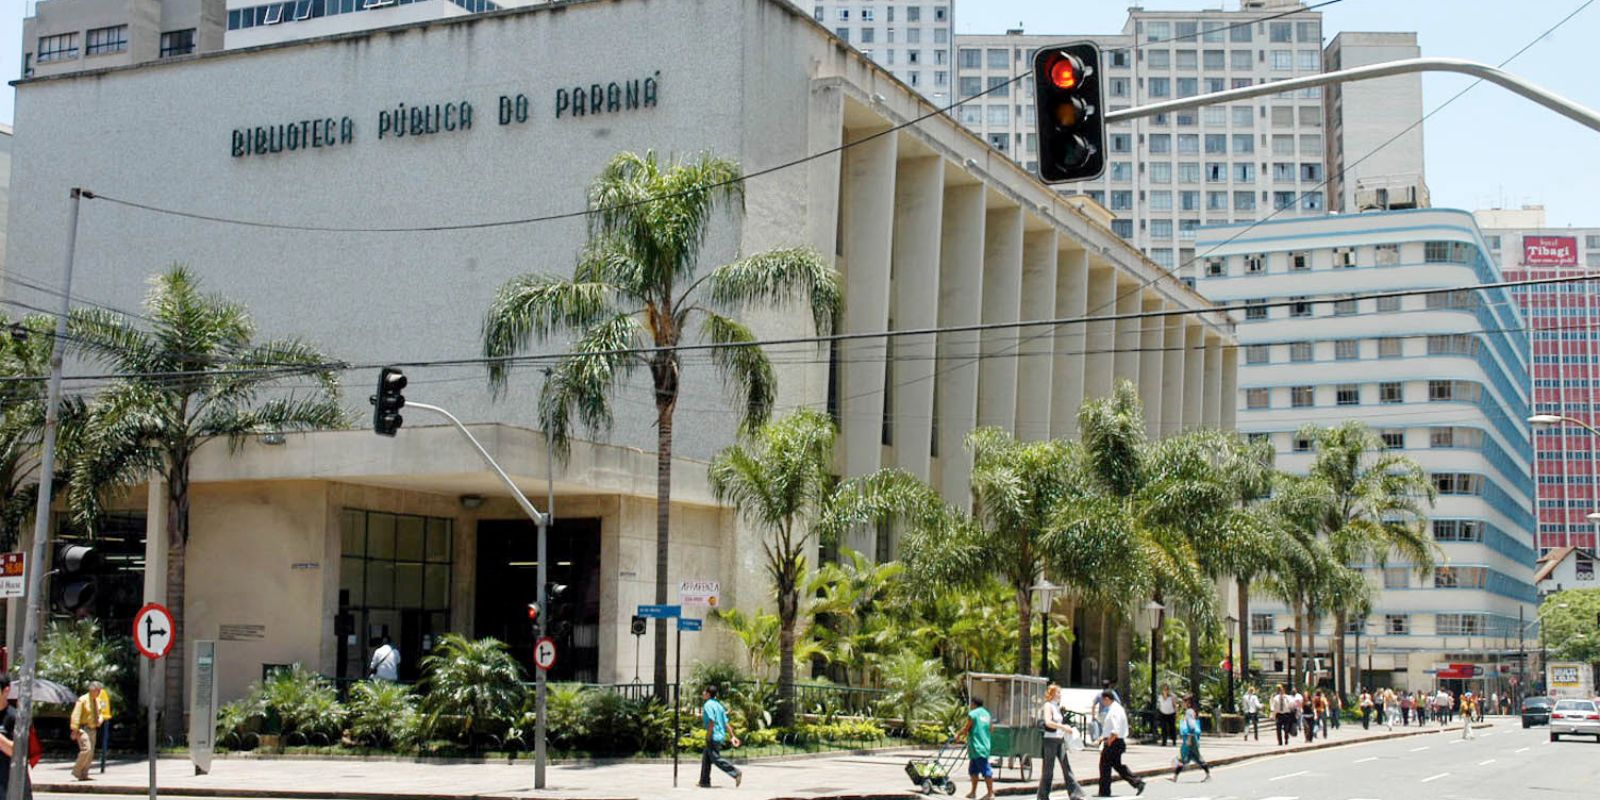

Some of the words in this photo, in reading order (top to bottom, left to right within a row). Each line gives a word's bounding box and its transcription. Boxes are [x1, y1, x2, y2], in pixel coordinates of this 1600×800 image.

[232, 116, 354, 157] BIBLIOTECA
[378, 102, 474, 139] PÚBLICA
[499, 94, 529, 125] DO
[556, 70, 661, 119] PARANÁ
[1527, 246, 1569, 258] Tibagi
